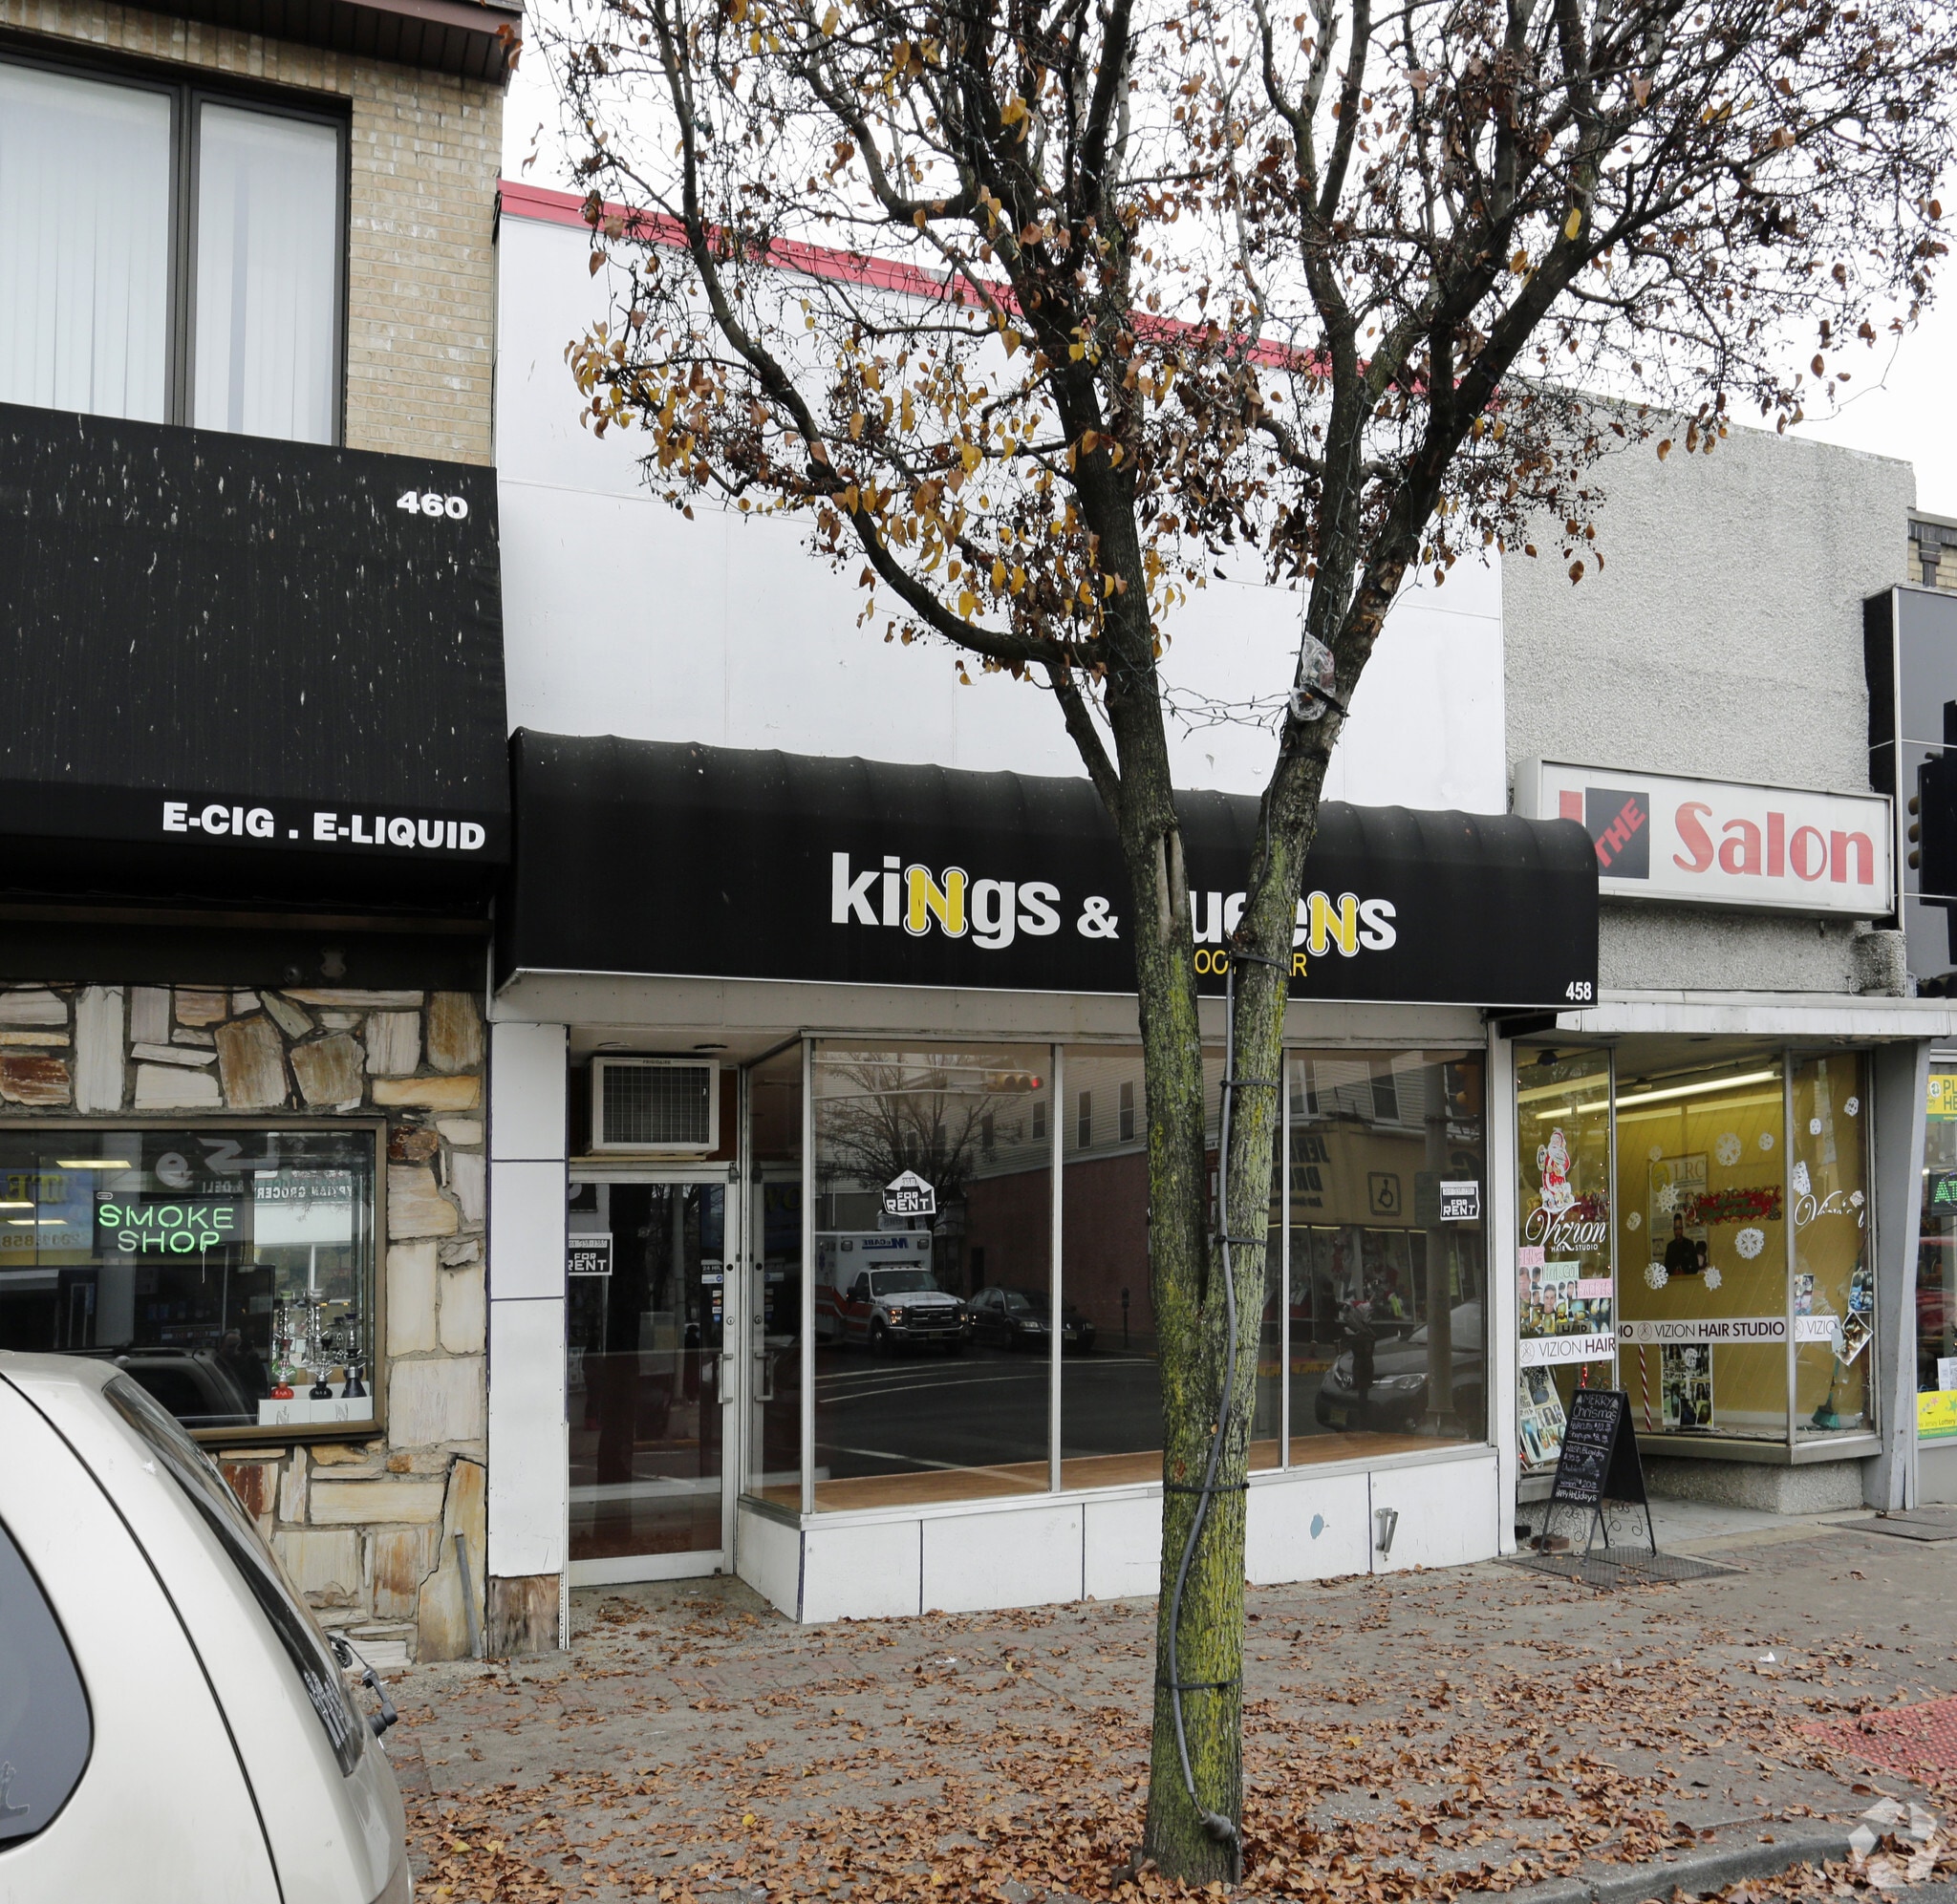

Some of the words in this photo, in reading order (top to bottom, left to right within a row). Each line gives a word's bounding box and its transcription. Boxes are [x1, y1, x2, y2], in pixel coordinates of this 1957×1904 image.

[397, 491, 468, 519] 460
[162, 802, 274, 838] E-CIG
[312, 812, 485, 850] E-LIQUID
[1594, 797, 1648, 868] THE
[1672, 801, 1874, 886] Salon
[1076, 896, 1120, 939] &
[1565, 981, 1592, 1001] 458
[886, 1198, 930, 1211] RENT
[896, 1191, 918, 1200] FOR
[98, 1204, 234, 1230] SMOKE
[1443, 1205, 1476, 1216] RENT
[1525, 1202, 1606, 1252] Vizion
[118, 1230, 221, 1253] SHOP
[1654, 1324, 1695, 1338] VIZION
[1698, 1323, 1730, 1337] HAIR
[1732, 1321, 1785, 1337] STUDIO
[1807, 1320, 1837, 1335] VIZIO
[1538, 1340, 1581, 1358] VIZION
[1585, 1337, 1615, 1354] HAIR
